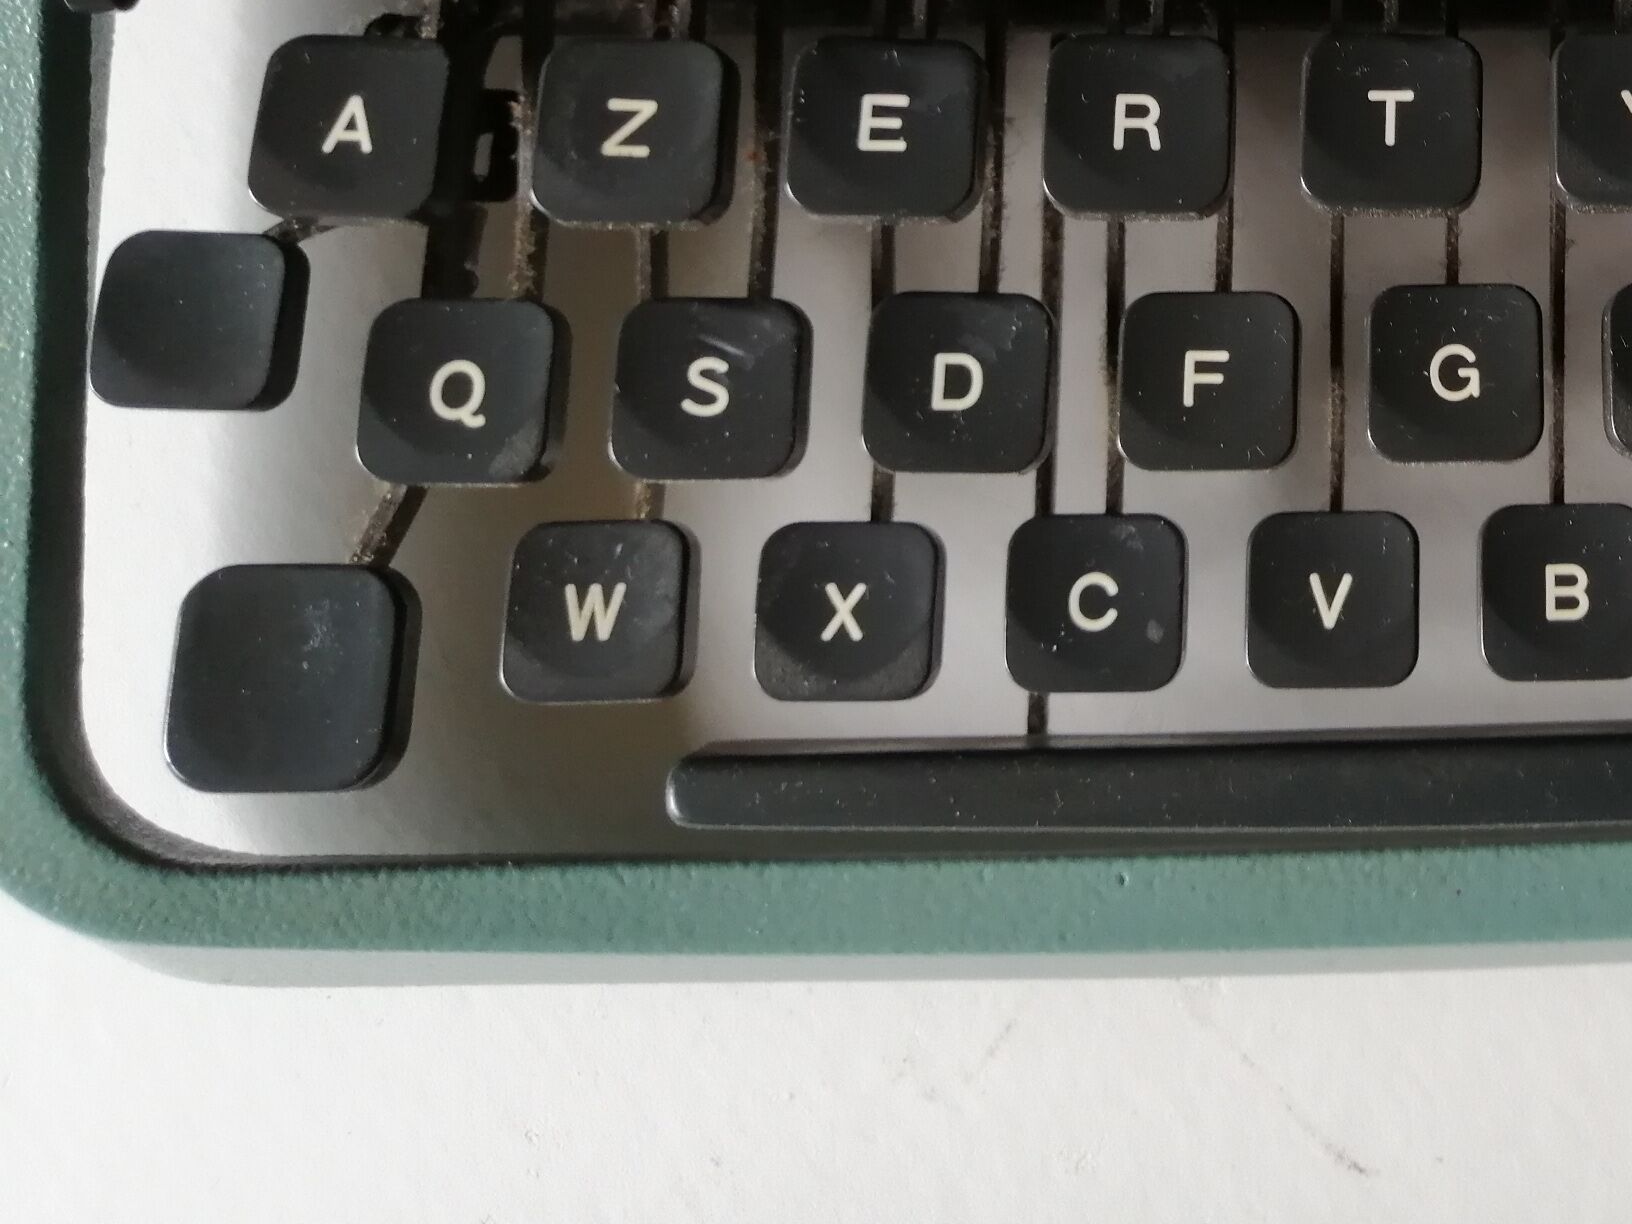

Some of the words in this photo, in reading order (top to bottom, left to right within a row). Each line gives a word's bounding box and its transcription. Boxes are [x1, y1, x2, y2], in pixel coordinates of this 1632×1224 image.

[321, 94, 373, 154] A
[601, 97, 659, 158] Z
[857, 93, 911, 152] E
[1112, 93, 1162, 151] R
[1367, 89, 1415, 147] T
[429, 359, 486, 429] Q
[680, 356, 730, 418] S
[930, 352, 984, 412] D
[1182, 349, 1230, 408] F
[1429, 343, 1481, 402] G
[564, 582, 627, 642] W
[820, 582, 867, 642] X
[1068, 571, 1119, 632] C
[1309, 572, 1353, 630] V
[1545, 563, 1590, 622] B
